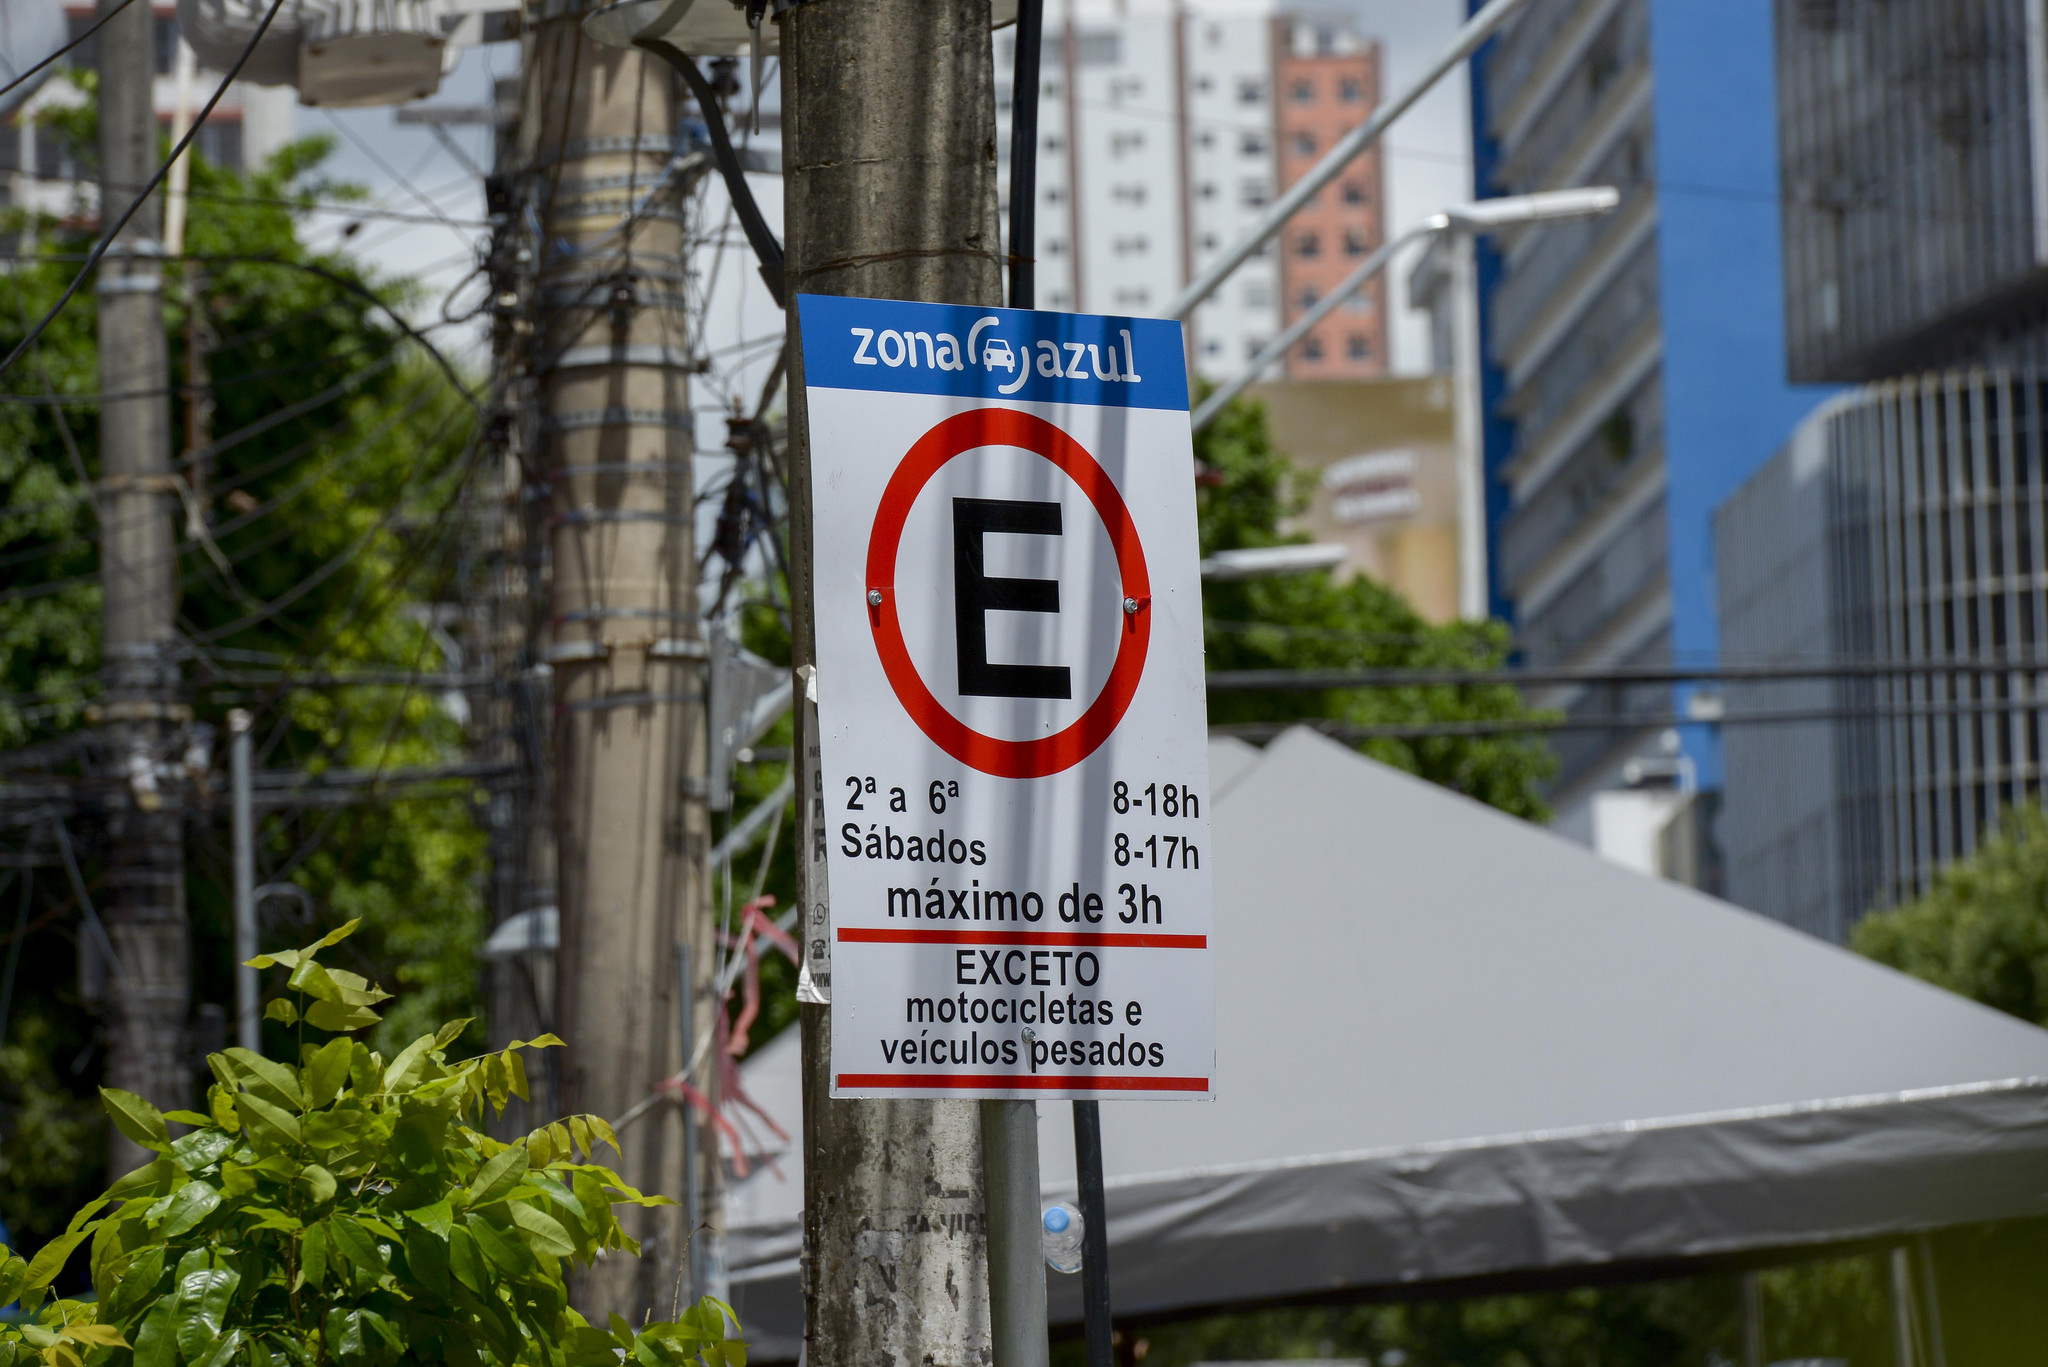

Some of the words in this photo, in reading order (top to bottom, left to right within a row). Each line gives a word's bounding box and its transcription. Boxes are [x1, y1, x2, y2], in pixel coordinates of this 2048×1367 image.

[850, 327, 964, 372] zona
[1036, 329, 1142, 384] azul
[952, 496, 1072, 700] E
[889, 787, 907, 813] a
[1113, 780, 1199, 819] 8-18h
[841, 822, 987, 866] Sábados
[1114, 832, 1199, 870] 8-17h
[887, 877, 1044, 923] máximo
[1058, 882, 1104, 924] de
[1117, 883, 1162, 925] 3h
[956, 949, 1100, 987] EXCETO
[906, 990, 1114, 1026] motocicletas
[1125, 1001, 1142, 1026] e
[880, 1029, 1018, 1066] veículos
[1029, 1031, 1164, 1074] pesados
